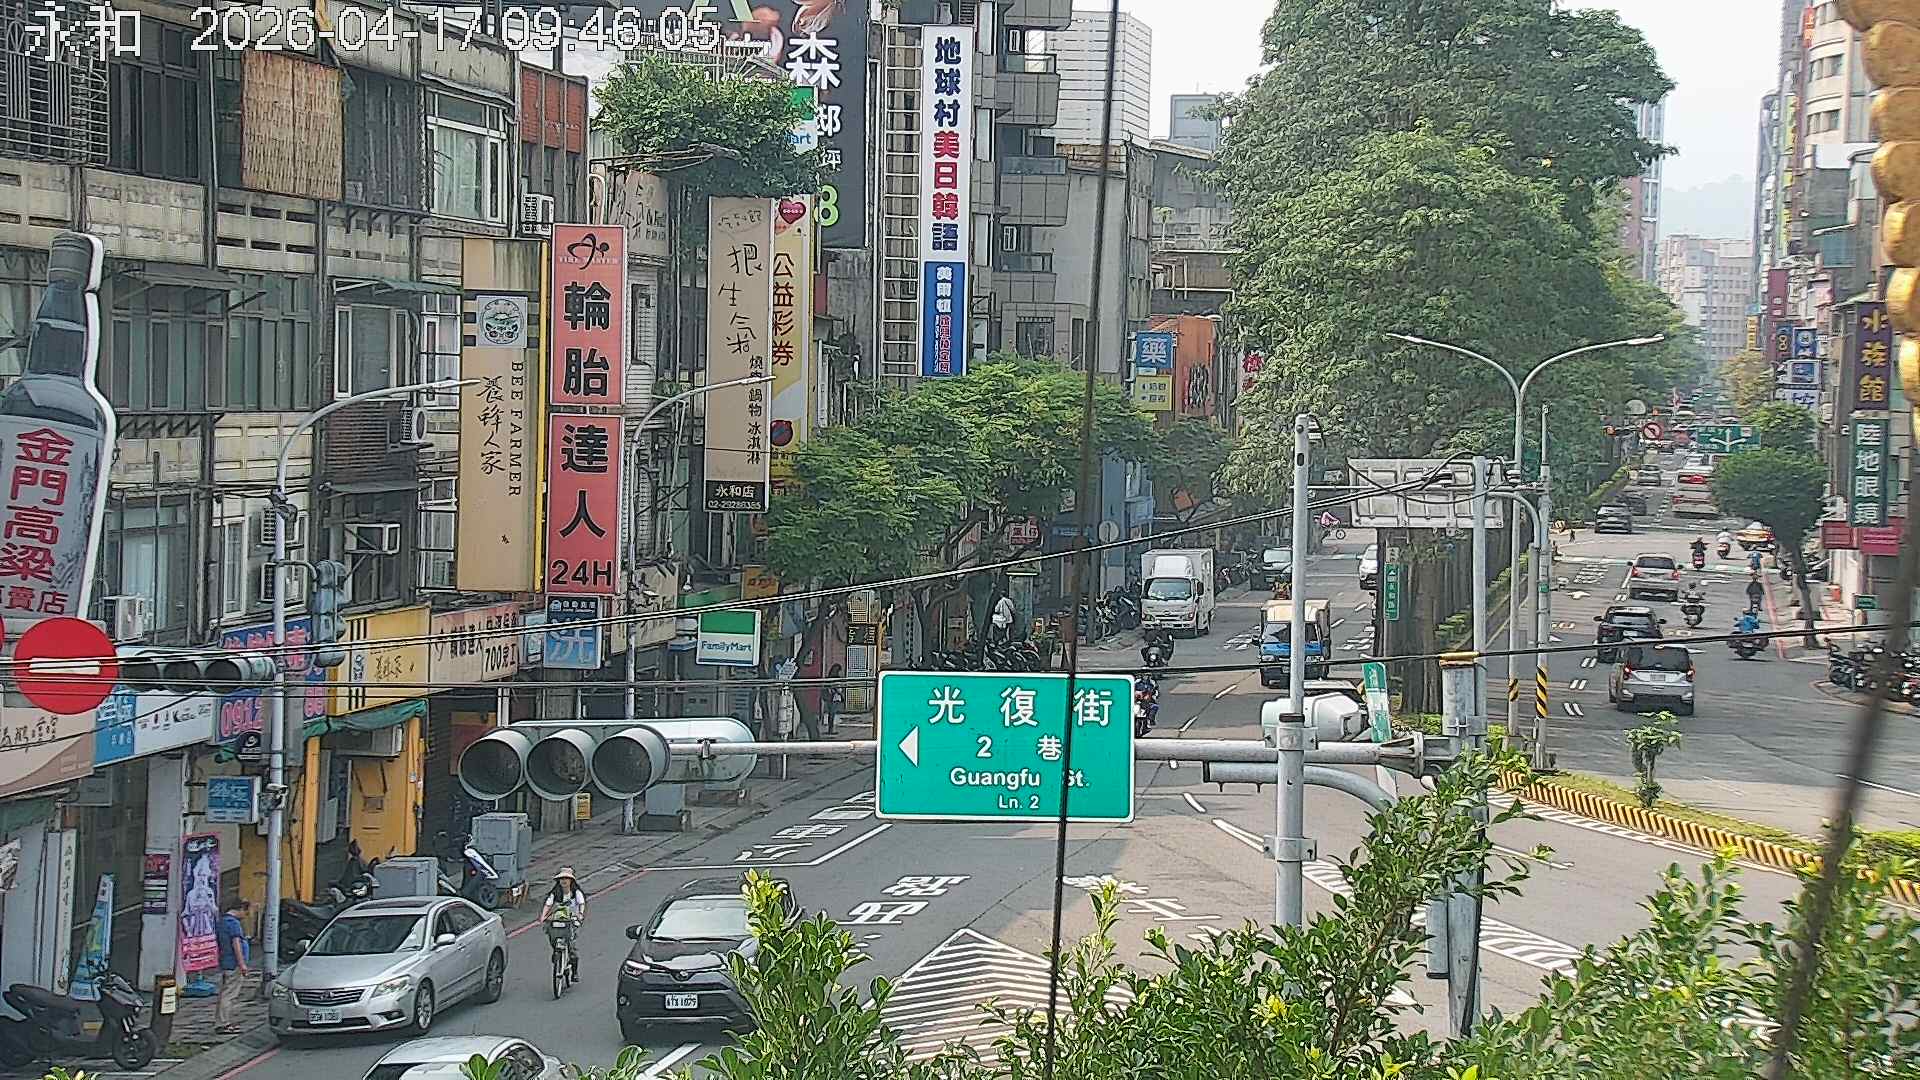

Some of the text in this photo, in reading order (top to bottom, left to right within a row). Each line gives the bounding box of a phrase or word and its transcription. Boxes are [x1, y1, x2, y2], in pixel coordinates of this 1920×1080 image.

[773, 253, 794, 366] 公益彩券
[508, 410, 523, 496] FARMER
[715, 484, 756, 499] 永和店
[551, 560, 612, 586] 24H
[0, 585, 69, 615] 賣店
[701, 641, 752, 654] FamilyMart
[928, 686, 1113, 727] 光復街
[950, 767, 1040, 790] Guangfu
[998, 794, 1040, 809] Ln. 2
